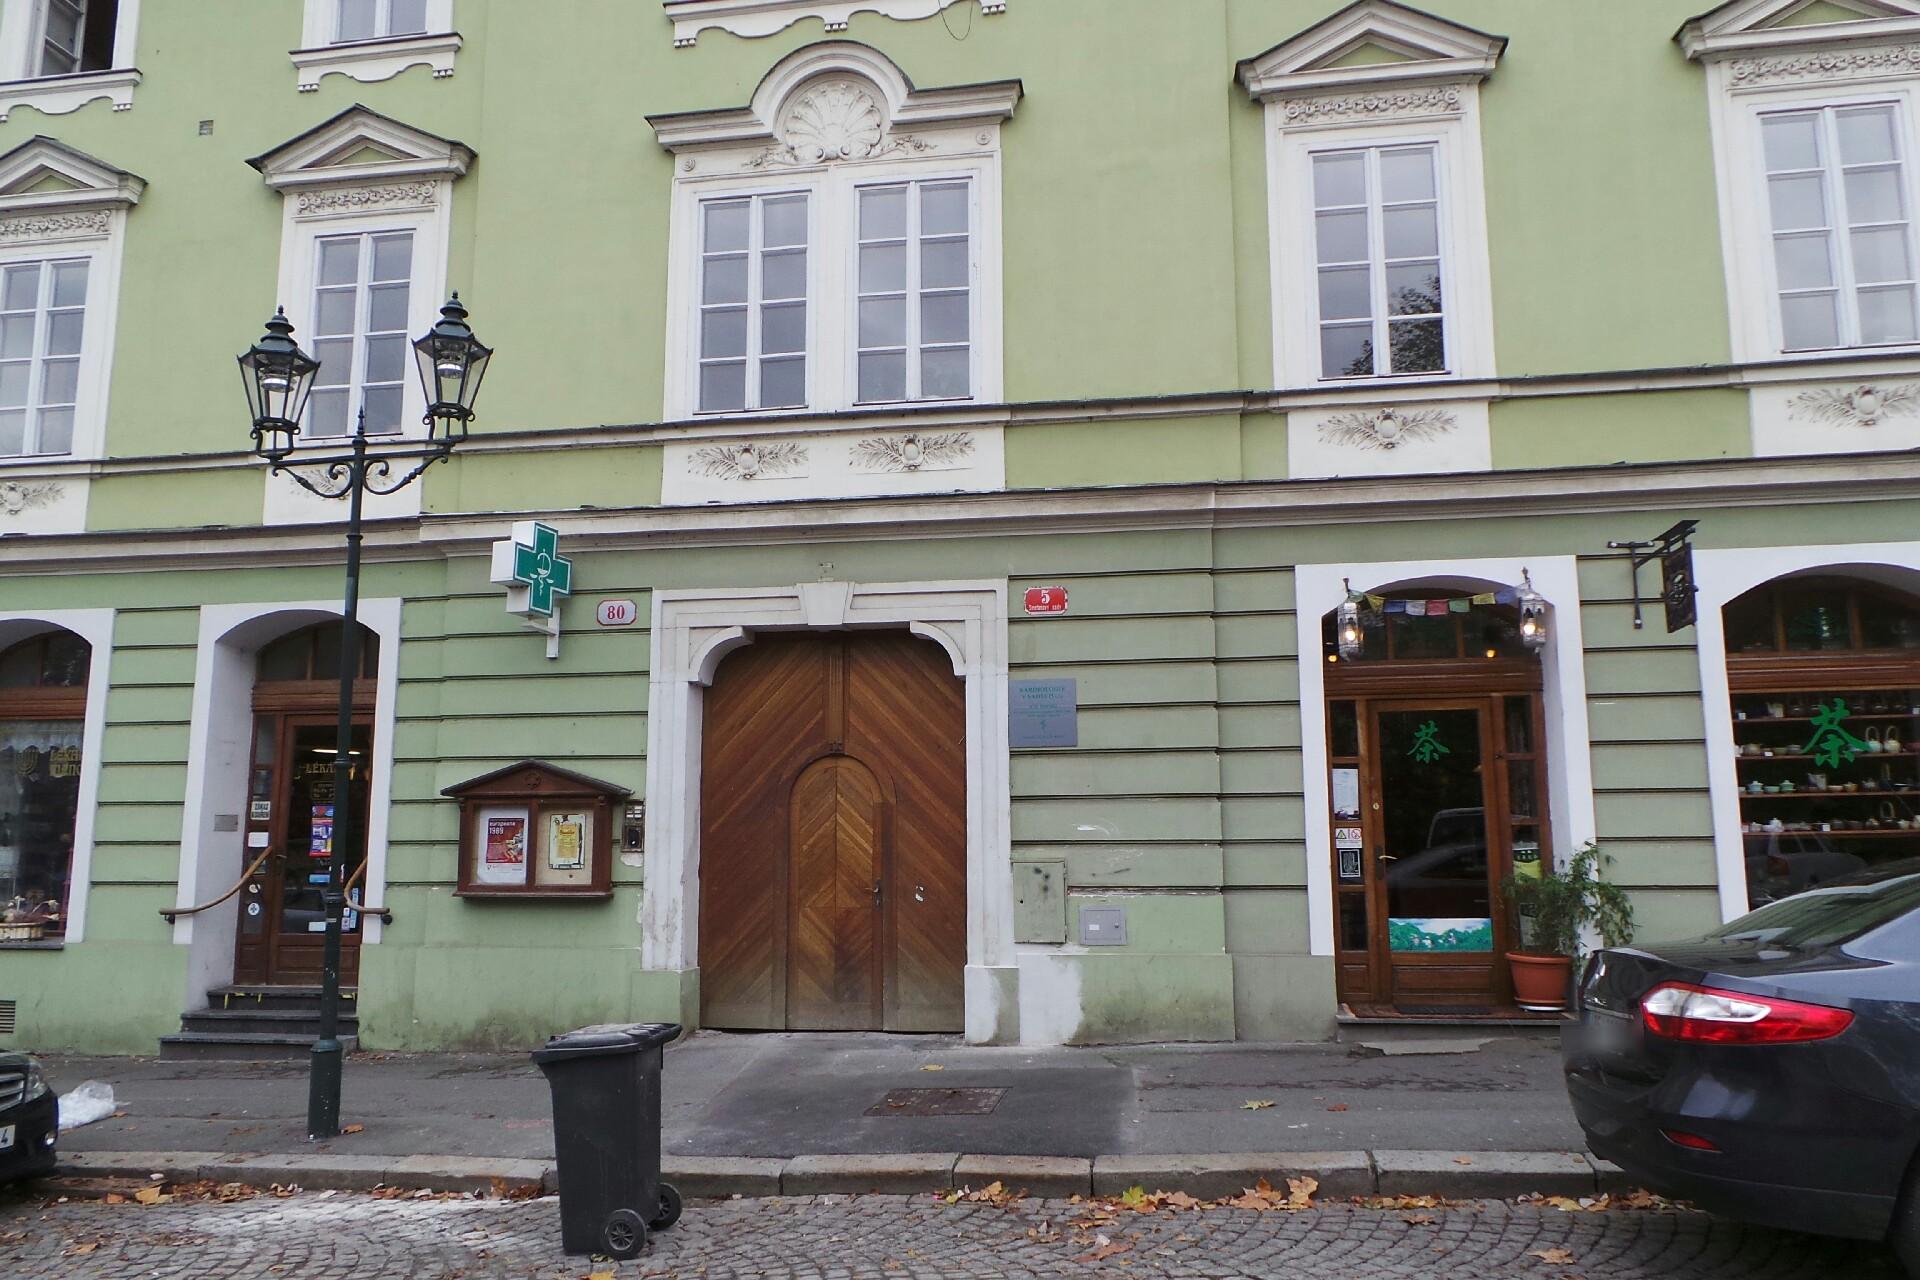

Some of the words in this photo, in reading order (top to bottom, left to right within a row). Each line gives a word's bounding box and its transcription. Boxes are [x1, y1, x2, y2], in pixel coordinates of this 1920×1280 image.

[1041, 589, 1051, 604] 5
[607, 604, 626, 620] 80
[1406, 719, 1451, 764] 茶
[1799, 697, 1872, 769] 茶
